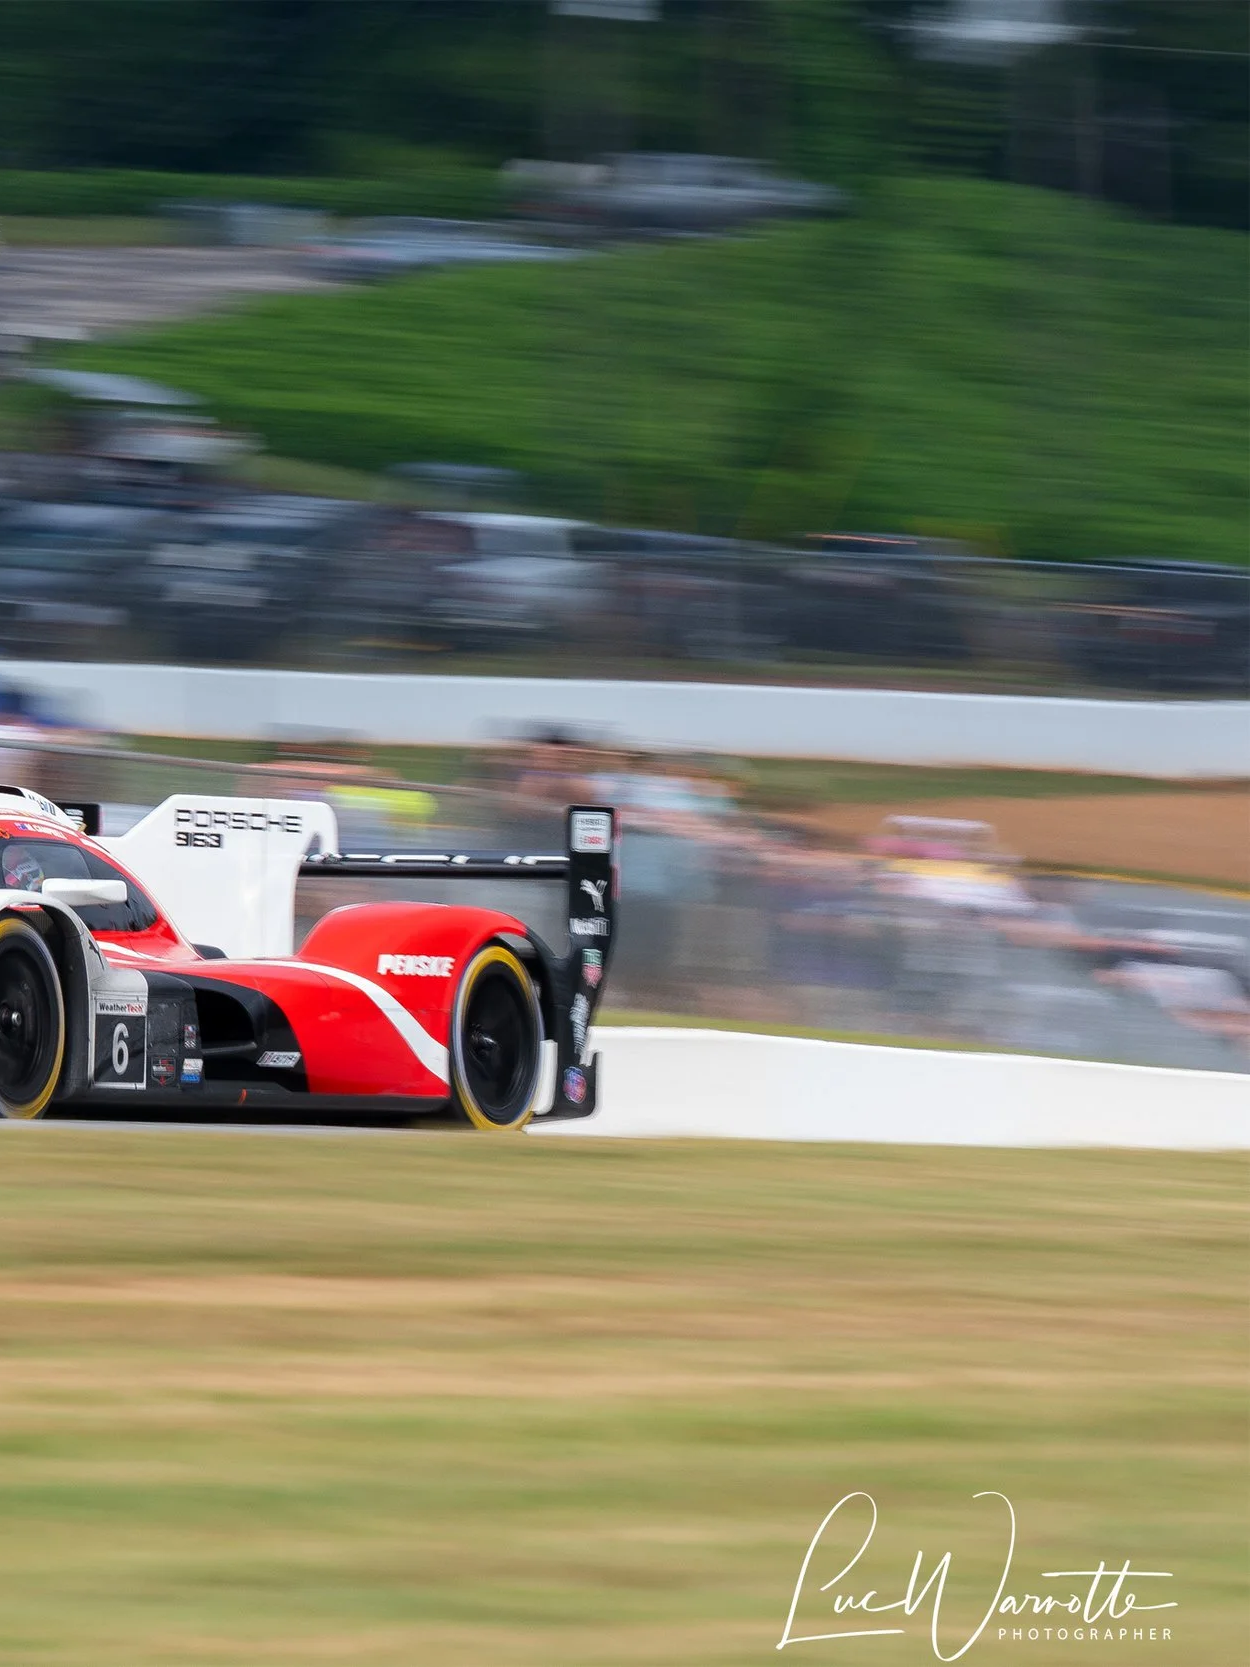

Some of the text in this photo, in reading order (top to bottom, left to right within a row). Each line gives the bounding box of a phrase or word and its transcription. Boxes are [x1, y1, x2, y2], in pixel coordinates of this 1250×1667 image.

[175, 809, 302, 833] PORSCHE
[175, 832, 222, 848] 963
[377, 954, 456, 977] PENSKE
[99, 1003, 144, 1013] WeatherTech
[112, 1022, 129, 1076] 6
